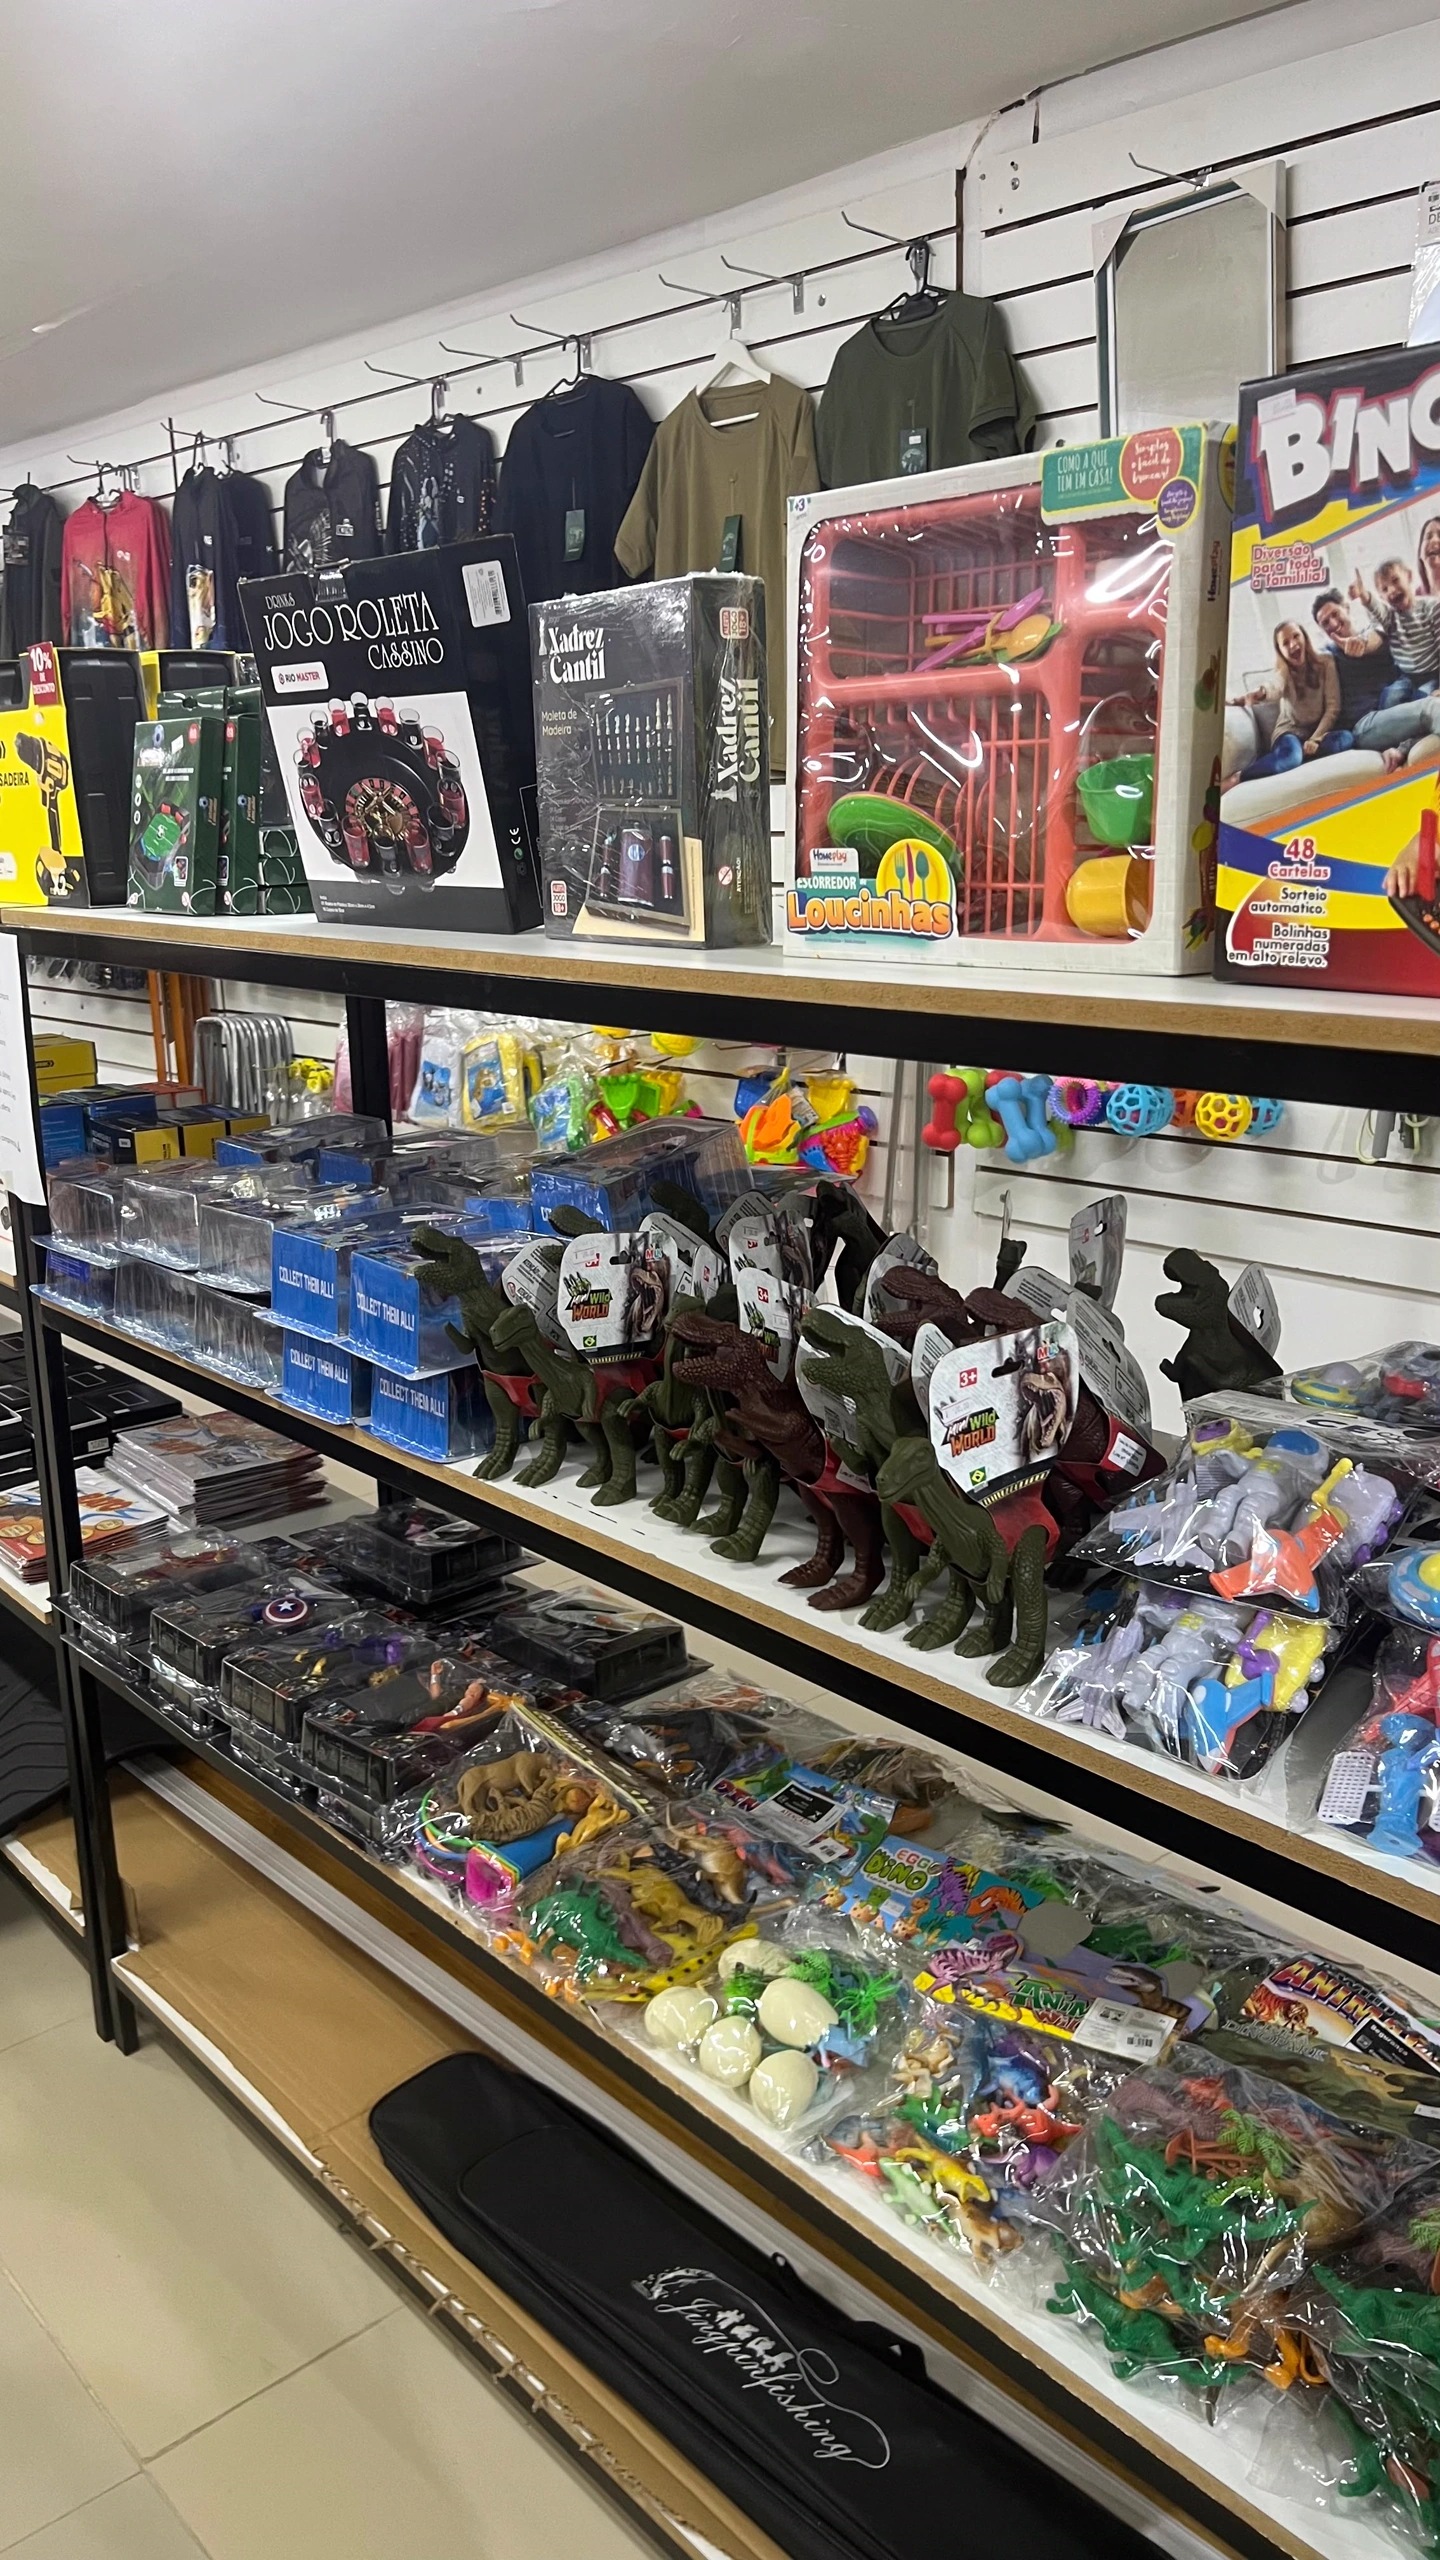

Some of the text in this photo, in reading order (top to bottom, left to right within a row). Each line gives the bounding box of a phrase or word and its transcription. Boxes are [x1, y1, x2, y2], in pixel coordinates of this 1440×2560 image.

[1057, 453, 1080, 474] COMO
[1091, 448, 1108, 471] QUE
[1057, 466, 1112, 492] TEM EM CASA!
[1253, 541, 1311, 561] Diversão
[1253, 557, 1321, 577] para toda
[1252, 578, 1261, 589] a
[263, 606, 334, 651] JOGO
[335, 591, 440, 642] ROLETA
[547, 622, 604, 655] Xadrez
[30, 646, 52, 672] 10%
[367, 637, 444, 670] CASSINO
[297, 671, 321, 682] MASTER
[549, 648, 606, 684] Cantil
[567, 708, 578, 720] de
[542, 725, 572, 736] Madeira
[715, 676, 739, 784] Xadrez
[738, 677, 761, 783] Cantil
[1286, 838, 1315, 860] 48
[1268, 862, 1329, 879] Cartelas
[796, 875, 857, 890] ESCORREDOR
[1281, 887, 1327, 901] Sorteio
[787, 888, 953, 939] Loucinhas
[1250, 901, 1326, 915] automático.
[1272, 924, 1328, 939] Bolinhas
[1254, 939, 1327, 952] numeradas
[1228, 950, 1326, 966] em alto relevo.
[279, 1265, 335, 1299] COLLECT THEM ALL!
[758, 1288, 769, 1302] 3+
[356, 1291, 415, 1333] COLLECT THEM ALL!
[572, 1304, 610, 1322] WORLD
[290, 1348, 349, 1384] COLLECT THEM ALL!
[960, 1372, 977, 1387] 3+
[379, 1378, 445, 1418] COLLECT THEM ALL!
[970, 1410, 997, 1431] Wild
[950, 1427, 996, 1458] WORLD
